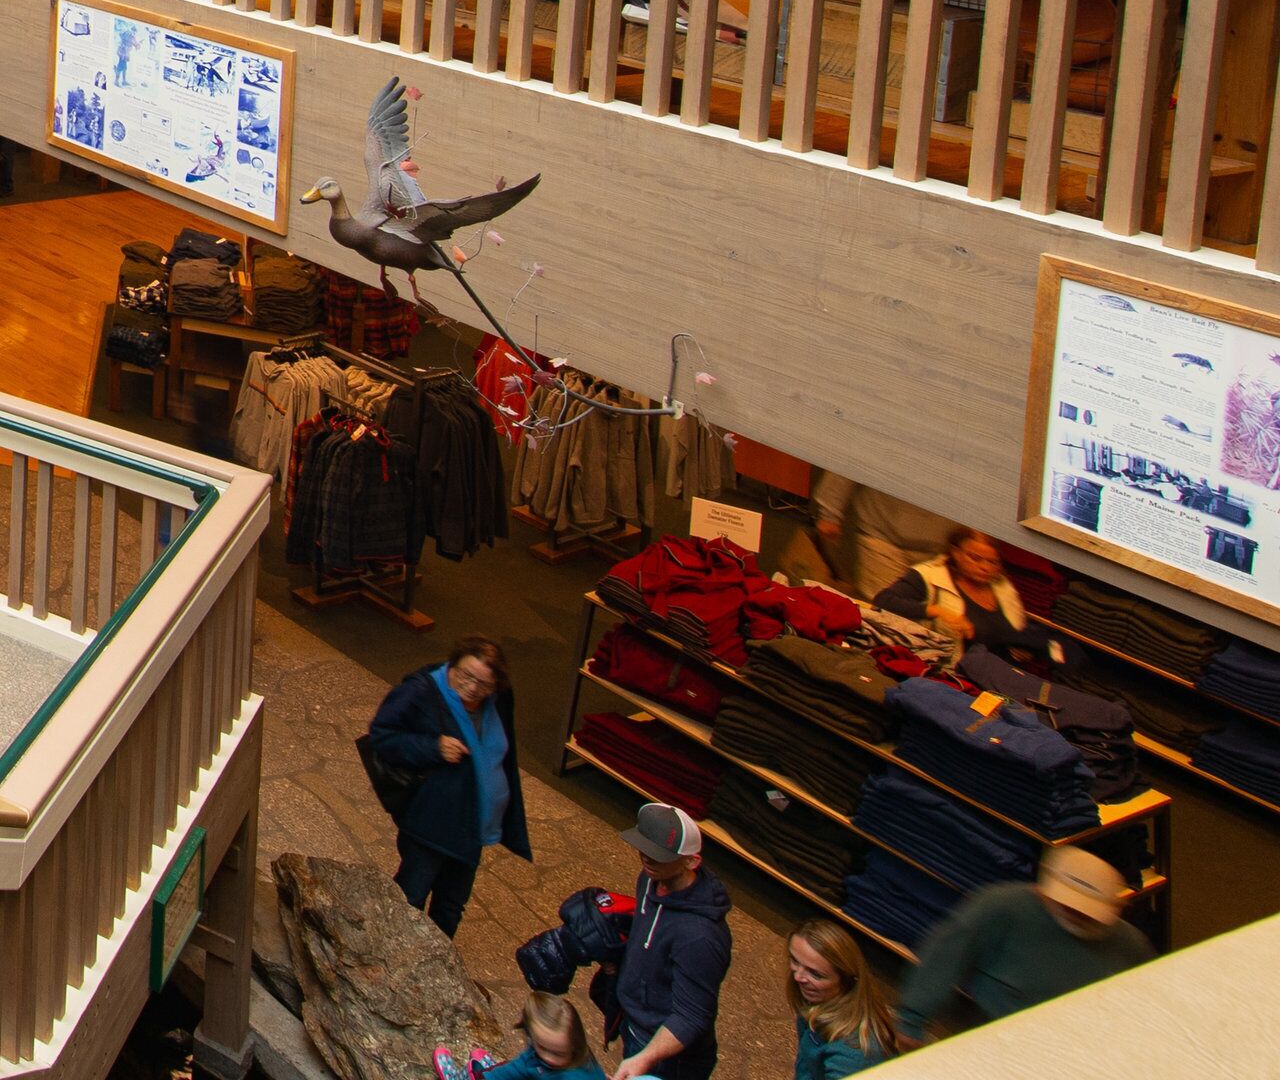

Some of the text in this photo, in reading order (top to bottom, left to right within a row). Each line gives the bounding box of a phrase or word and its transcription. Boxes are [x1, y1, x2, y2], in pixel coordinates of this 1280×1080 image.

[1208, 321, 1220, 331] Fly
[1109, 486, 1202, 524] State of Maine Pack
